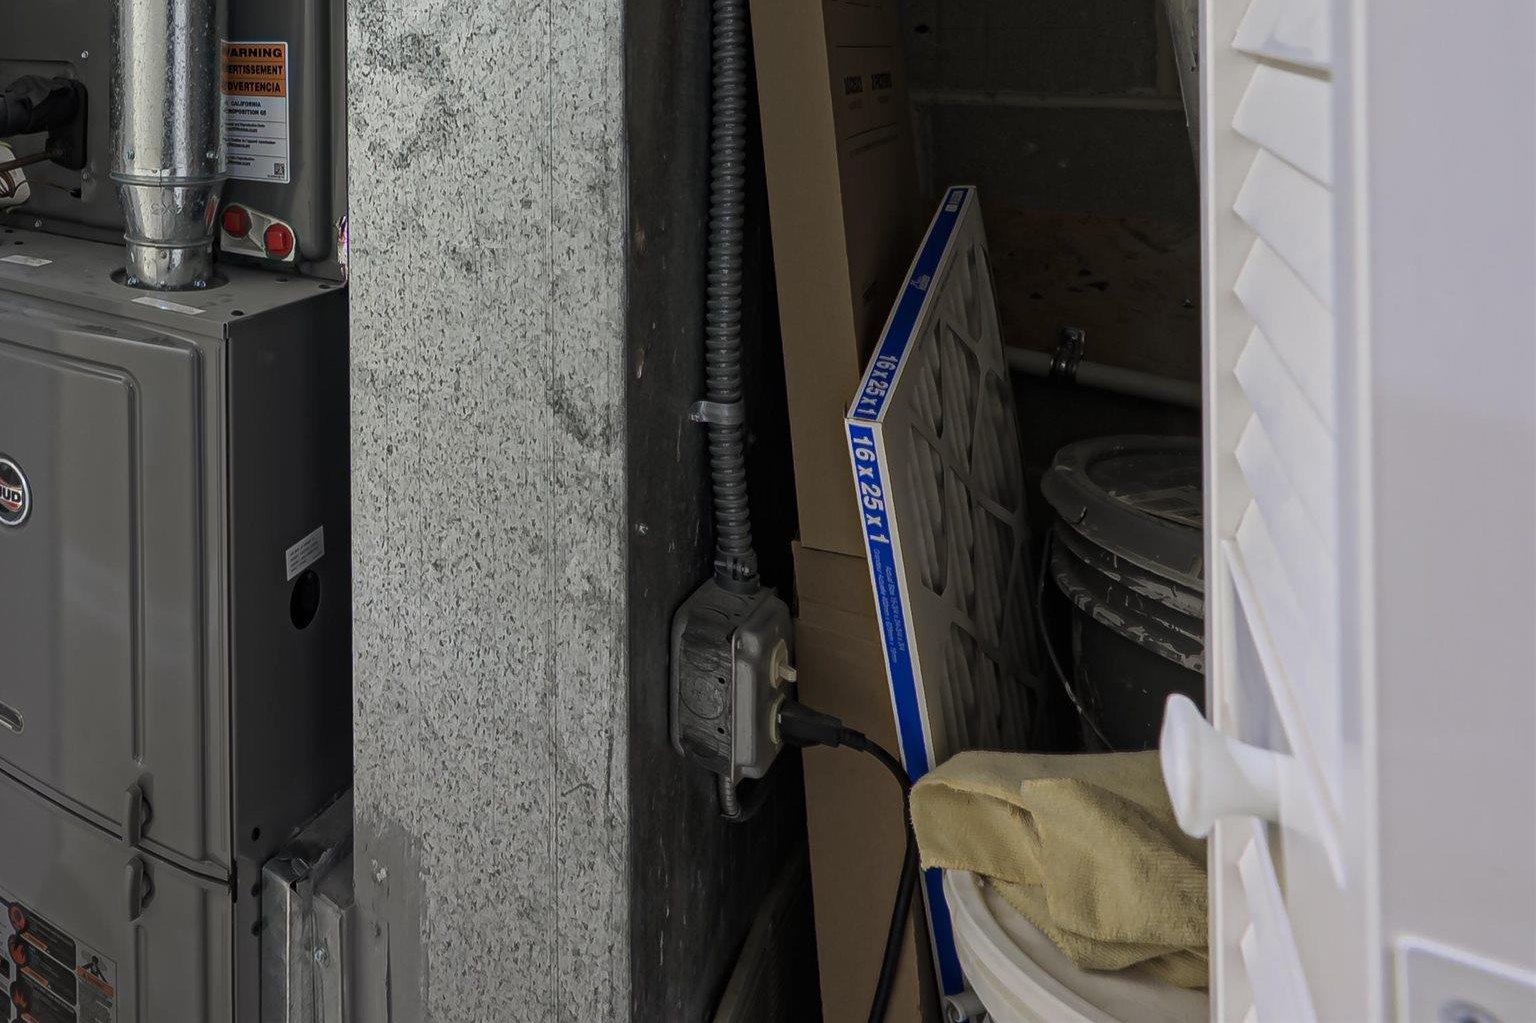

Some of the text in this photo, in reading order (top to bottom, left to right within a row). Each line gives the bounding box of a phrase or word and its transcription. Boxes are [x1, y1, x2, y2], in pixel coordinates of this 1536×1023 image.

[228, 64, 283, 76] ERTISSEMENT
[230, 100, 262, 108] CALIFORNIA
[228, 108, 259, 116] ROPOSITION
[856, 355, 899, 415] 16 x 25 x 1
[851, 434, 890, 546] 16 x 25 x 1
